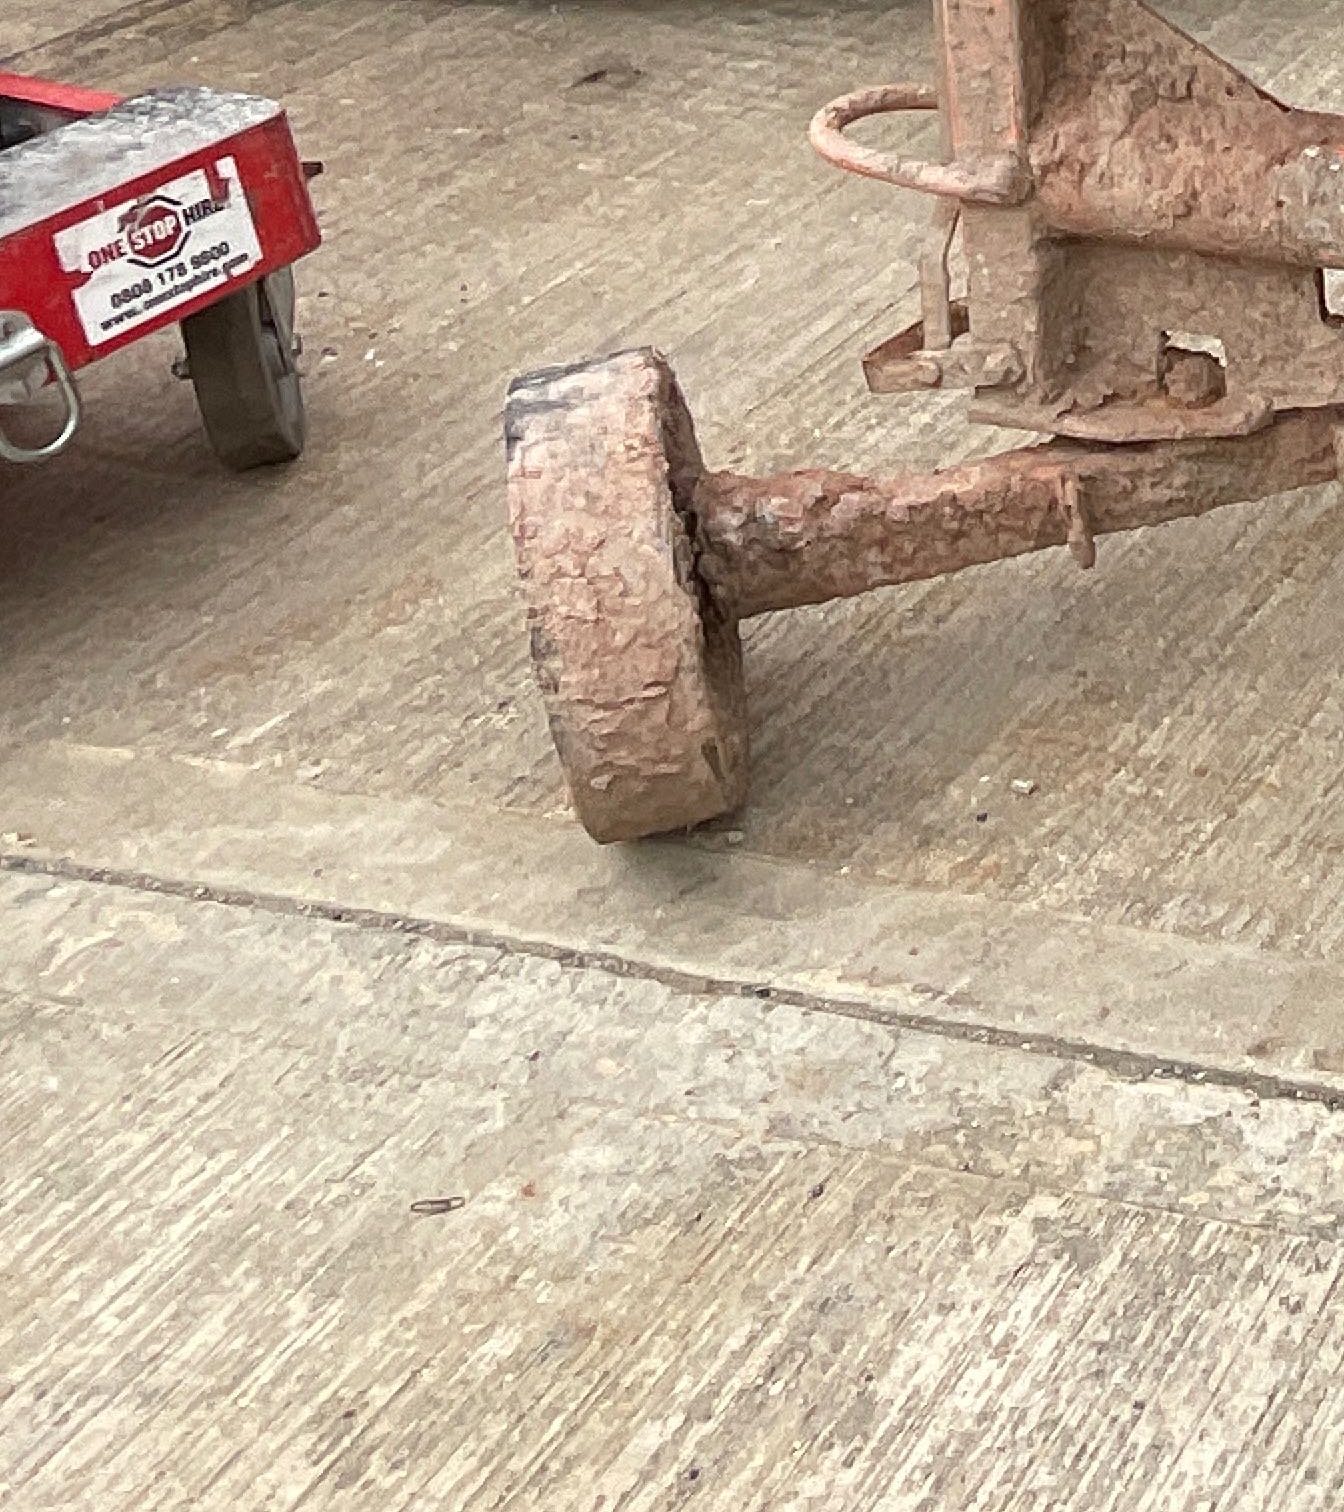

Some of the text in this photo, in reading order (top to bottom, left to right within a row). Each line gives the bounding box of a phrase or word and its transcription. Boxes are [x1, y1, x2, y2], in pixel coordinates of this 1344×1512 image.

[88, 239, 128, 269] ONE
[130, 214, 178, 250] STOP
[156, 262, 188, 286] 178
